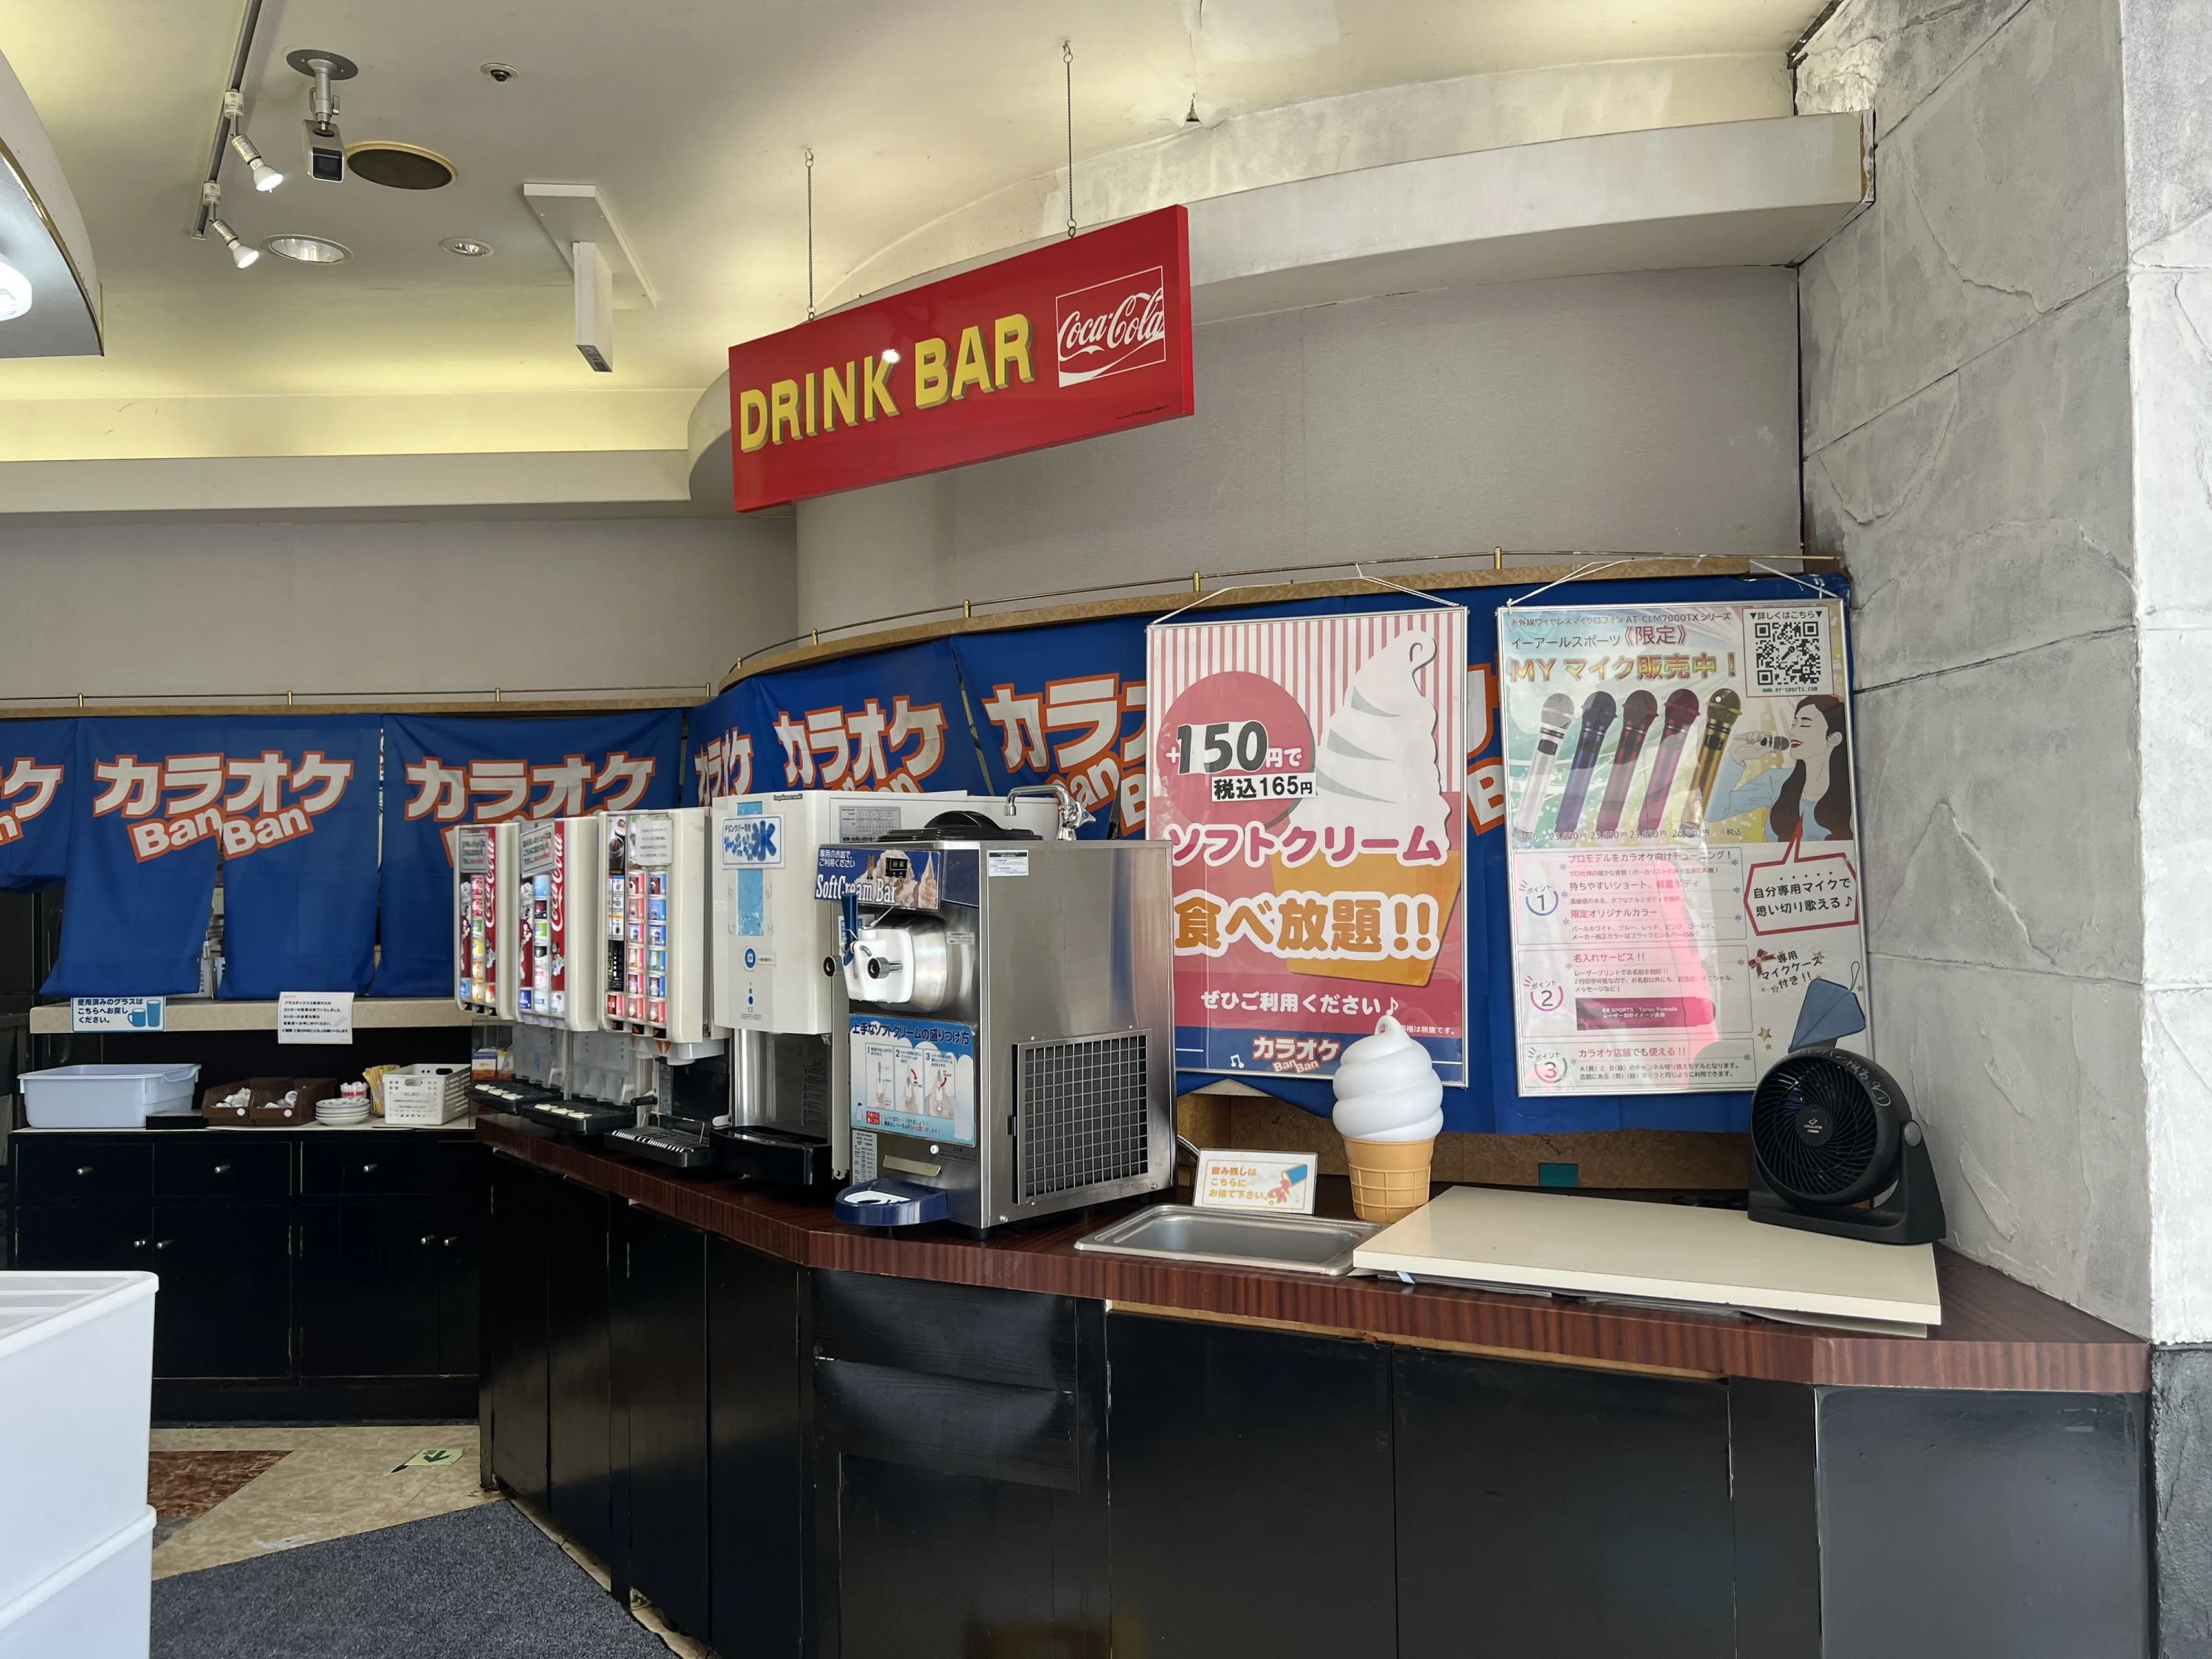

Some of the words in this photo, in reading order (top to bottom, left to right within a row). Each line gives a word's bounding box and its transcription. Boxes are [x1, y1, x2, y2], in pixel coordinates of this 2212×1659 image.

[1058, 286, 1165, 362] Coca-Cola
[740, 352, 900, 453] DRINK
[915, 313, 1035, 410] BAR
[1701, 612, 1731, 621] シリーズ
[1757, 611, 1814, 620] 詳しくはこちら
[1511, 657, 1557, 683] MY
[773, 695, 947, 789] カラオケ
[94, 750, 354, 819] カラオケ
[405, 751, 656, 821] カラオケ
[1214, 776, 1313, 800] 税込165円
[752, 820, 776, 861] 氷
[1168, 824, 1443, 863] ソフトクリーム
[818, 858, 855, 868] ご利用ください
[875, 878, 897, 904] Bar
[1526, 885, 1552, 894] ポイント
[1753, 877, 1851, 899] 自分専用マイクで
[1537, 894, 1545, 911] 1
[1571, 908, 1658, 919] 限定オリジナルカラー
[1777, 950, 1798, 963] 専用
[1761, 956, 1823, 981] マイクケース
[1531, 979, 1557, 990] ポイント
[77, 998, 144, 1006] 使用済みのグラスは
[1541, 990, 1553, 1007] 2
[77, 1006, 129, 1015] こちらへお戻し
[78, 1016, 111, 1024] ください。
[852, 1021, 970, 1046] 上手なソフトクリームの盛りつけ方
[895, 1049, 900, 1057] 2
[925, 1052, 931, 1060] 3
[1253, 1035, 1340, 1062] カラオケ
[1536, 1052, 1561, 1062] ポイント
[1544, 1062, 1557, 1078] 3
[1211, 1166, 1257, 1177] 飲み残しは
[1210, 1179, 1247, 1188] こちらに
[1208, 1189, 1267, 1200] お捨て下さい。
